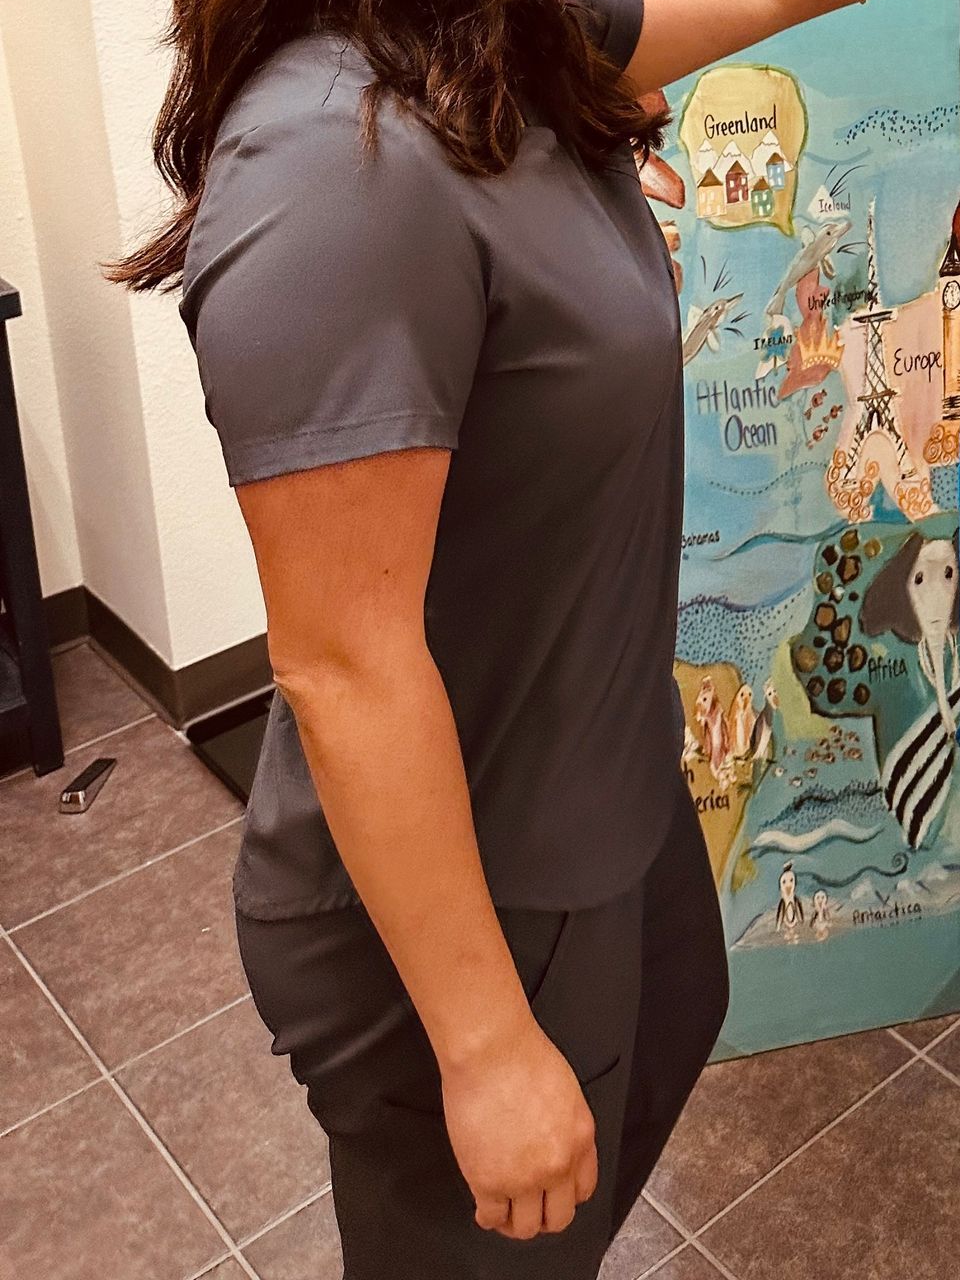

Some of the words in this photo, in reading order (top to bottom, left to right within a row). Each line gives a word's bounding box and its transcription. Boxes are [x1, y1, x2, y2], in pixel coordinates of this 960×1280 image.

[704, 104, 777, 139] Greenland
[894, 348, 942, 382] Europe
[697, 380, 780, 415] Atlantic
[725, 415, 777, 451] Ocean
[868, 655, 908, 683] Africa
[696, 789, 730, 814] erica
